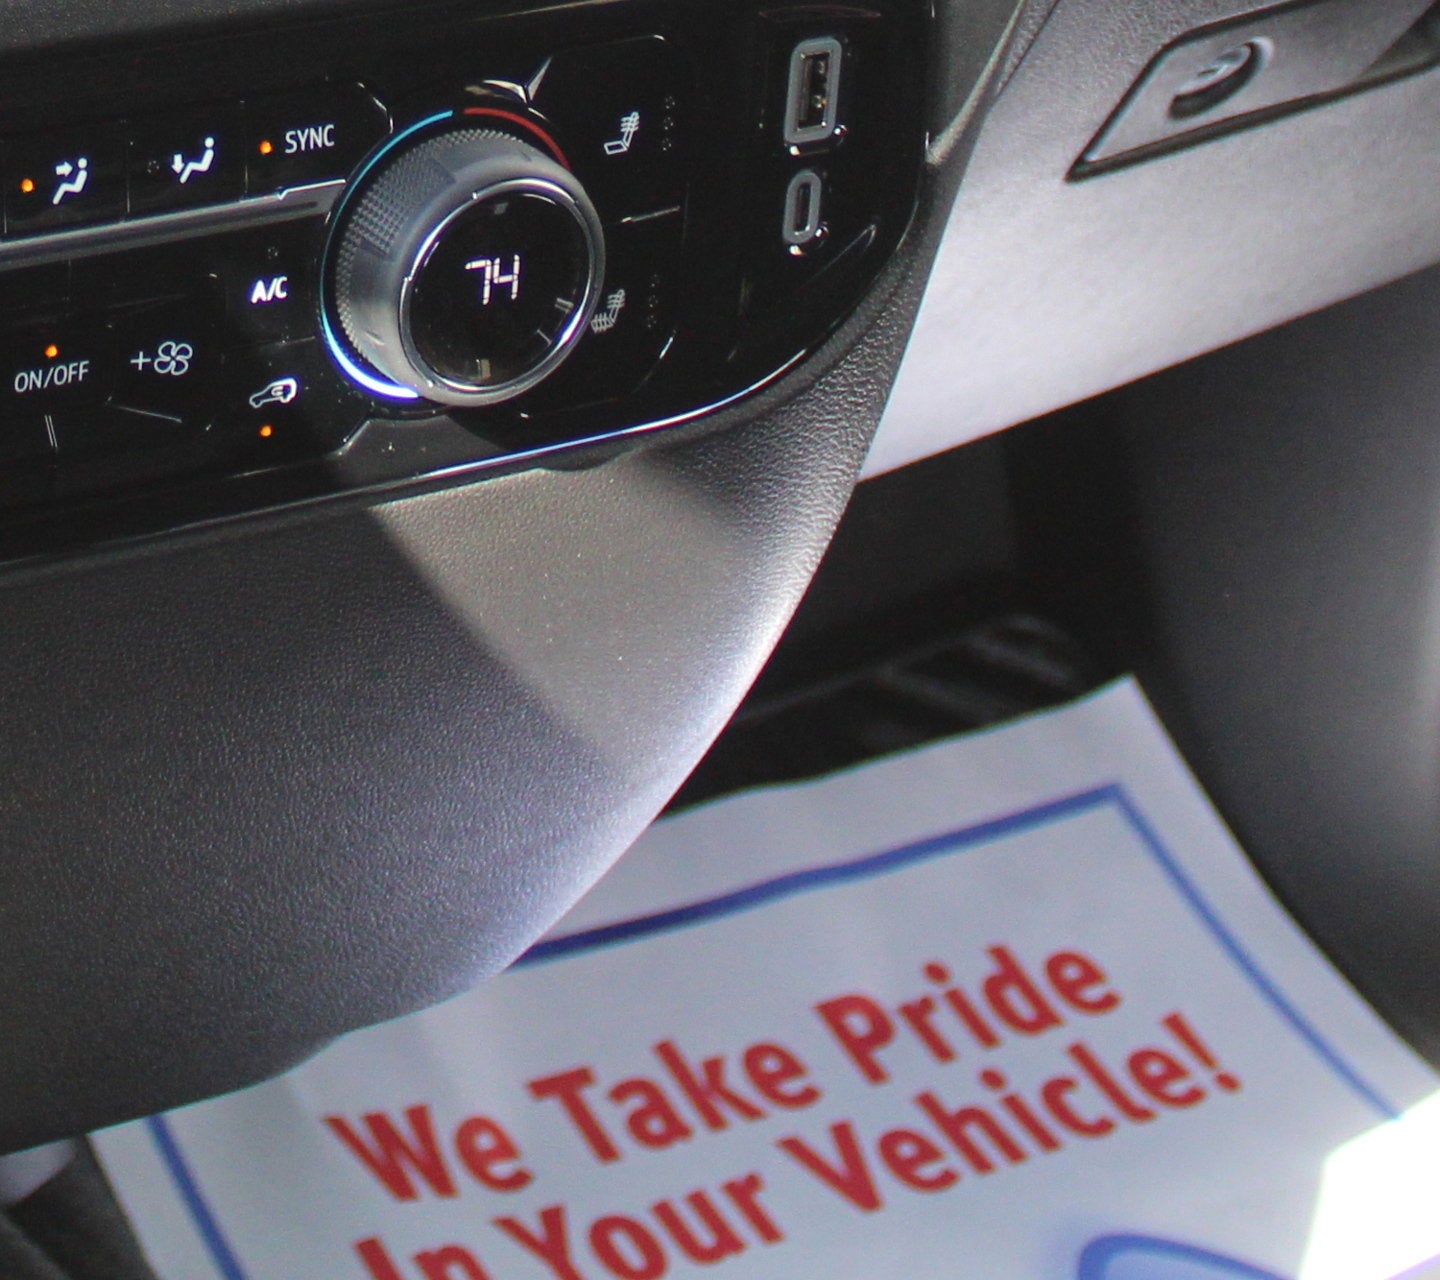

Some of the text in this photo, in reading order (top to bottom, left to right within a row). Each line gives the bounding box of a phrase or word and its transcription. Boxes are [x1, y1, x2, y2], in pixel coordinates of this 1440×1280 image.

[284, 123, 335, 154] SYNC
[250, 275, 288, 304] A/C
[464, 254, 520, 305] 74
[14, 360, 90, 393] ON/OFF
[326, 943, 1123, 1203] We Take Pride
[493, 1169, 789, 1280] Your
[775, 1011, 1243, 1213] Vehicle!
